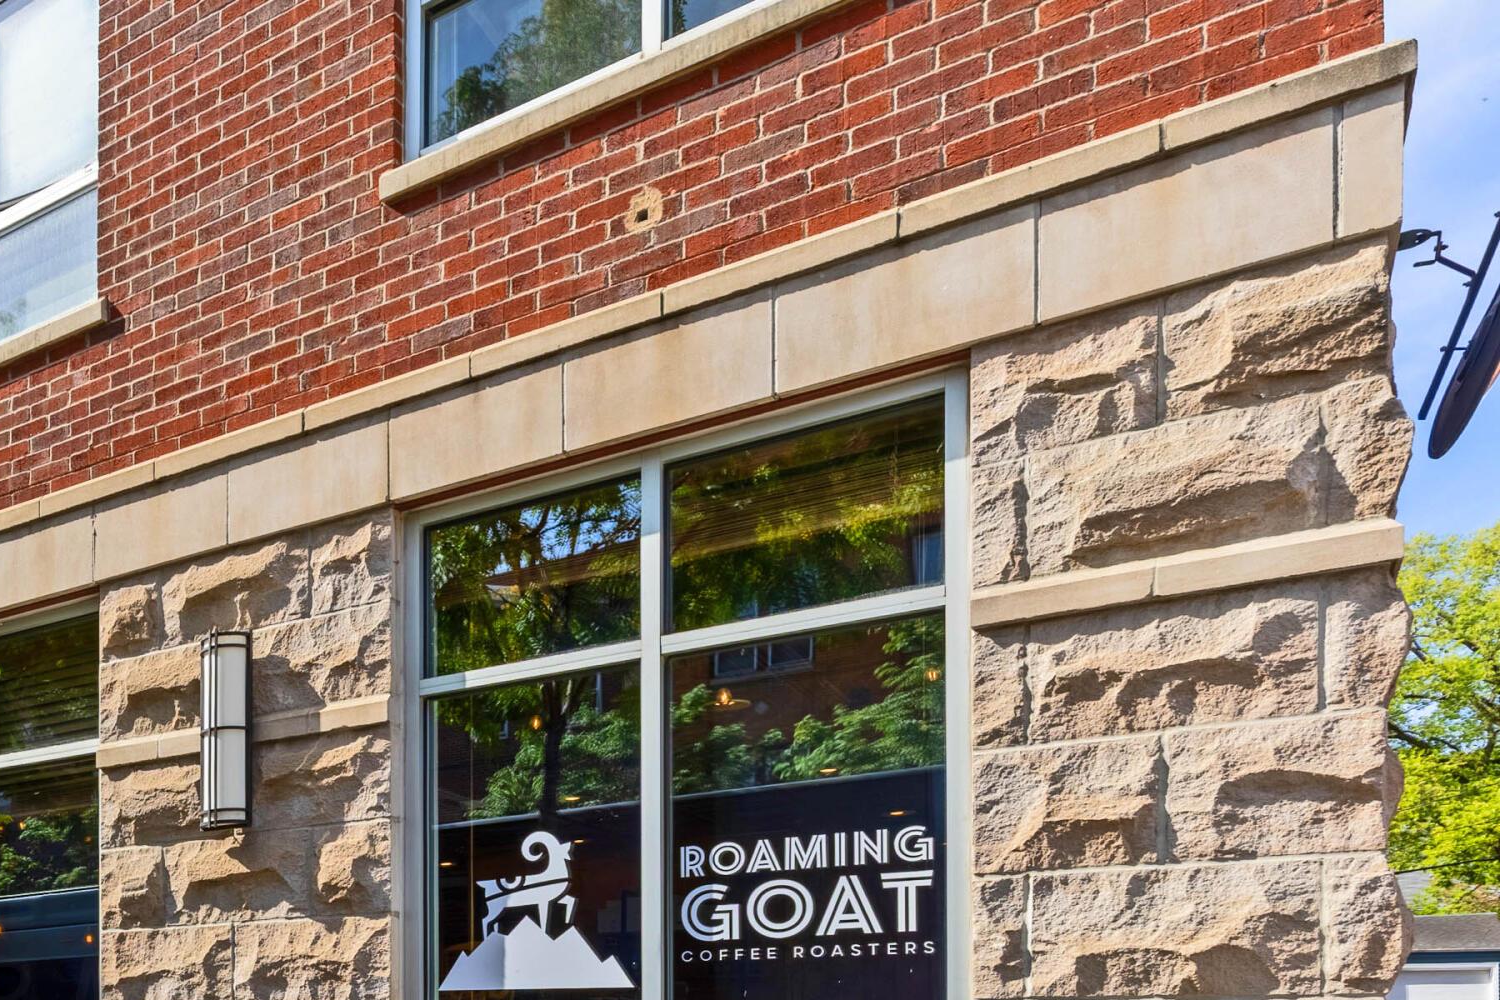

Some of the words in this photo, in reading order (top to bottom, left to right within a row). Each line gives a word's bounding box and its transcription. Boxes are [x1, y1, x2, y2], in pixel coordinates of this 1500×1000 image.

[680, 825, 934, 878] ROAMING
[681, 870, 934, 942] GOAT
[681, 946, 777, 962] COFFEE
[793, 941, 935, 958] ROASTERS
